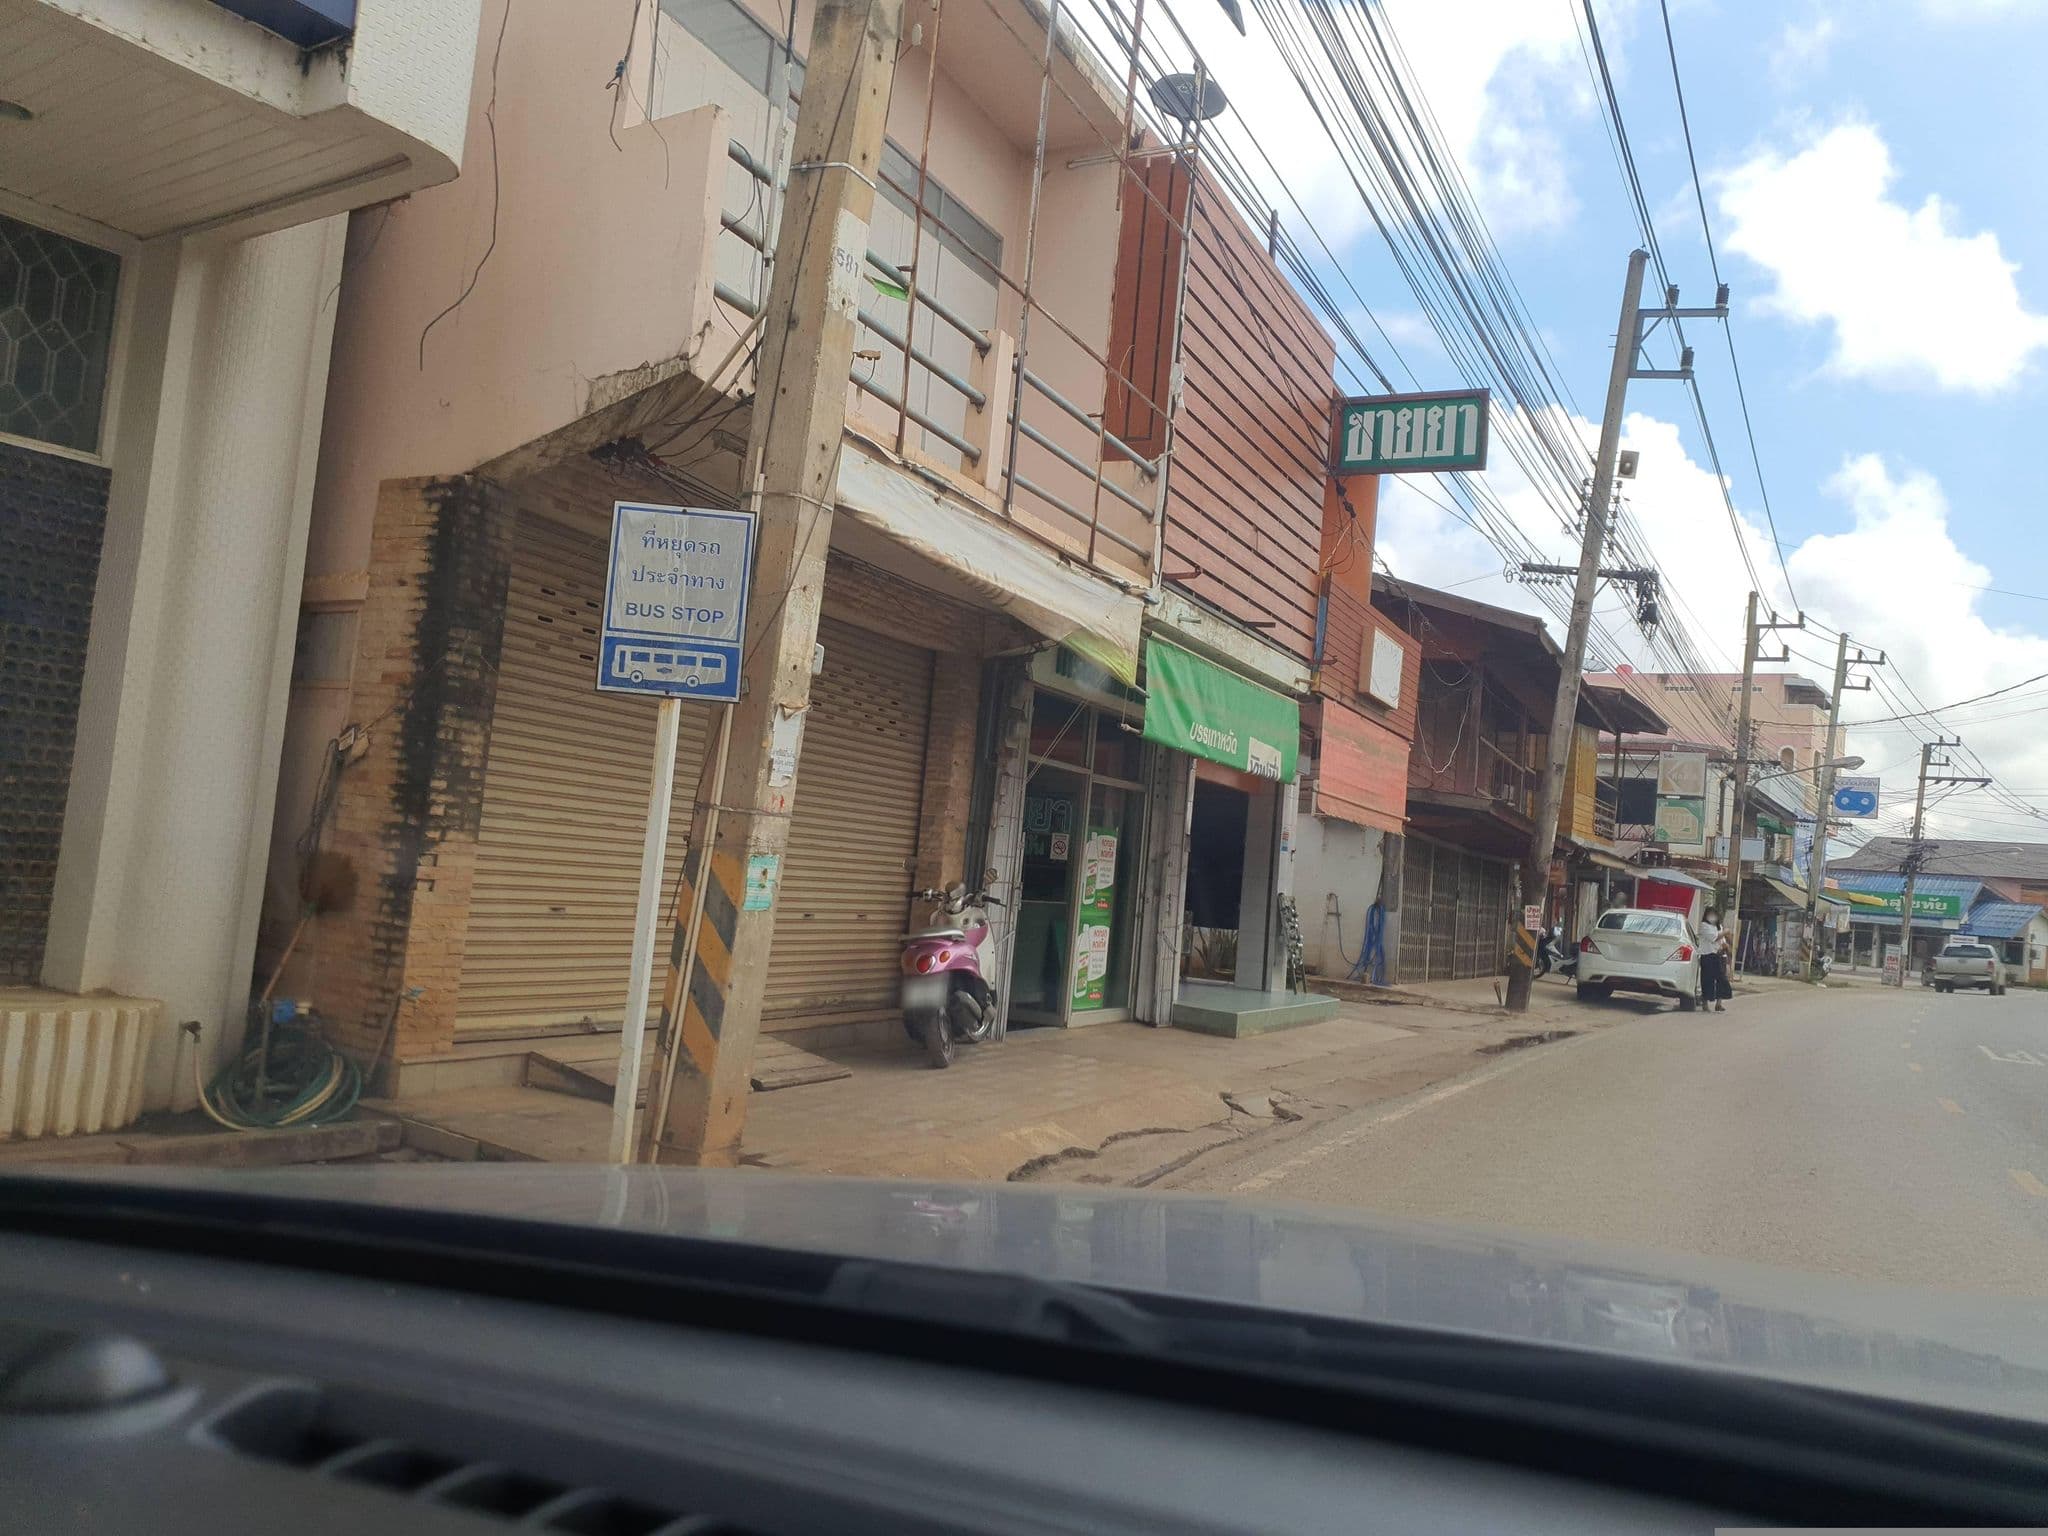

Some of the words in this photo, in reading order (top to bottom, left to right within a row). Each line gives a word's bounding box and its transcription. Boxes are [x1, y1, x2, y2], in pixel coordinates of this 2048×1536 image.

[1344, 404, 1478, 462] ขายยา
[642, 524, 721, 558] ที่หยุดรถ
[631, 565, 725, 591] ประจำทาง
[625, 602, 665, 619] BUS
[671, 606, 725, 624] STOP
[1189, 721, 1238, 755] บรรเทาหวัด
